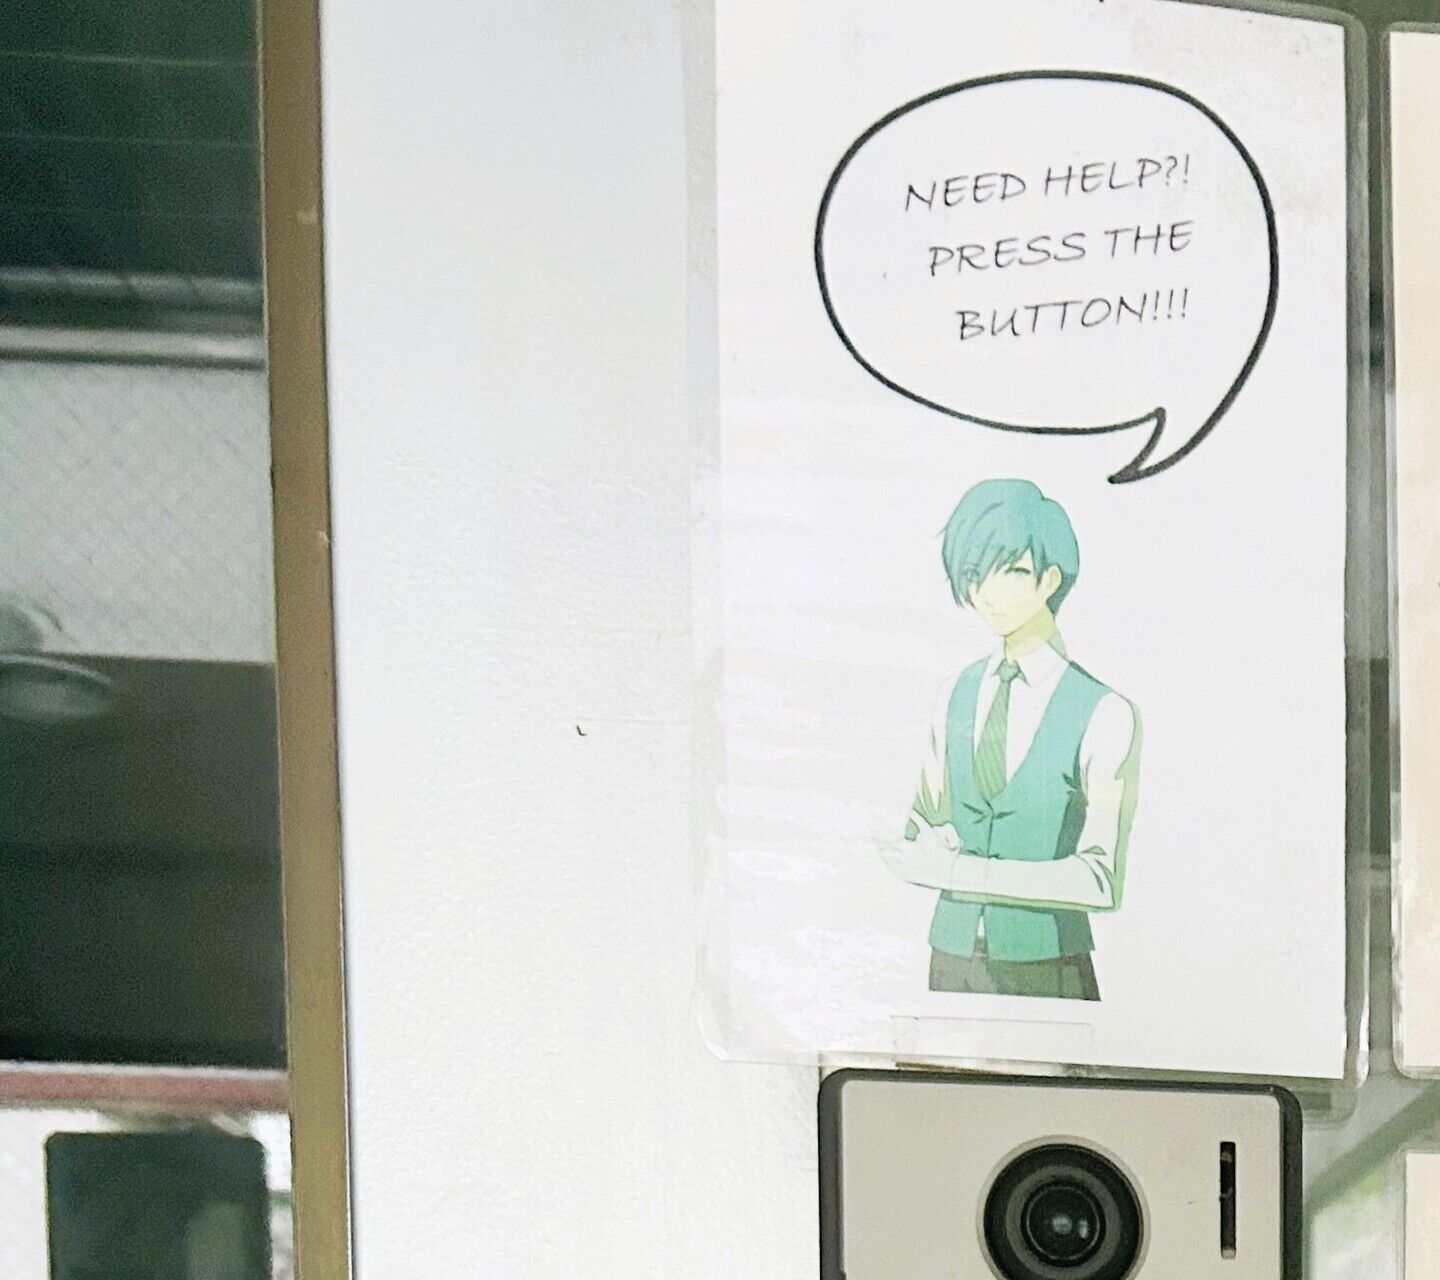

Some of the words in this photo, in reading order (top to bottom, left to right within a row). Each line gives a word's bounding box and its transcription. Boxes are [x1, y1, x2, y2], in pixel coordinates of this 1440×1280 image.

[905, 173, 1026, 211] NEED
[1045, 154, 1189, 196] HELP?!
[929, 232, 1086, 277] PRESS
[1104, 221, 1192, 258] THE
[955, 288, 1188, 341] BUTTON!!!
